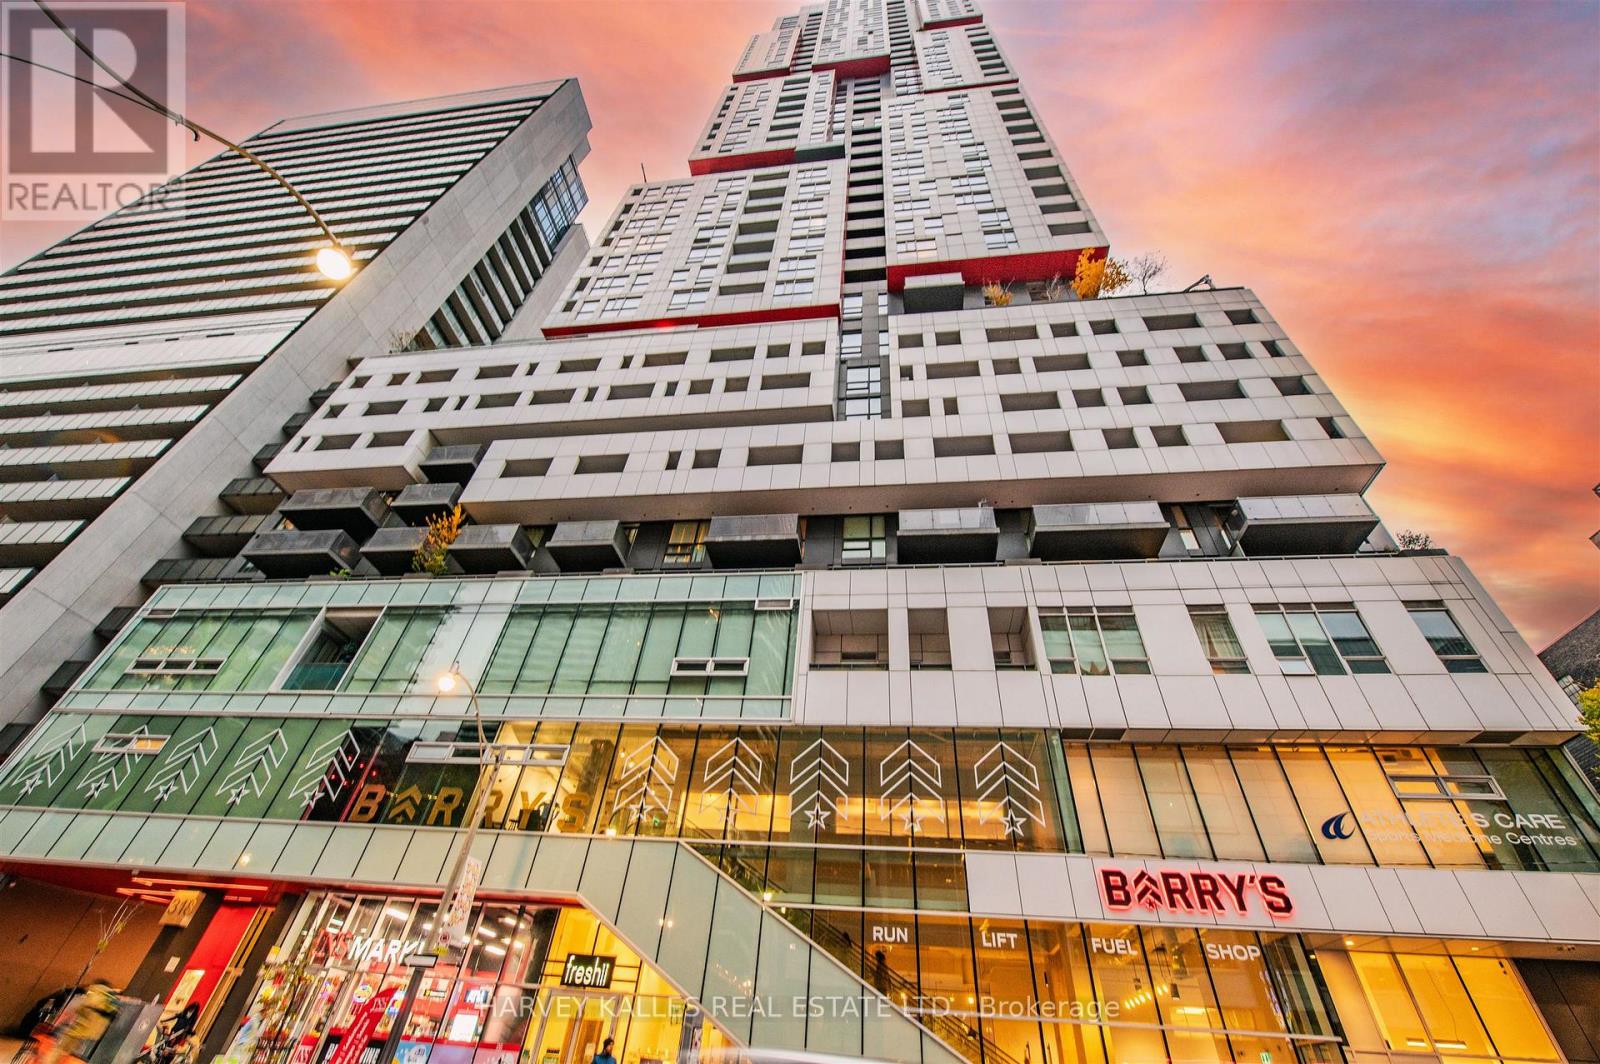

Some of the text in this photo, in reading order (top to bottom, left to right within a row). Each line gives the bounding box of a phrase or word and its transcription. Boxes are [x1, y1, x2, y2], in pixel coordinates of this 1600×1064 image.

[1494, 813, 1566, 829] CARE
[1505, 832, 1577, 846] Centres
[873, 926, 908, 943] RUN
[982, 931, 1017, 949] LIFT
[1091, 937, 1138, 955] FUEL
[1206, 943, 1261, 961] SHOP
